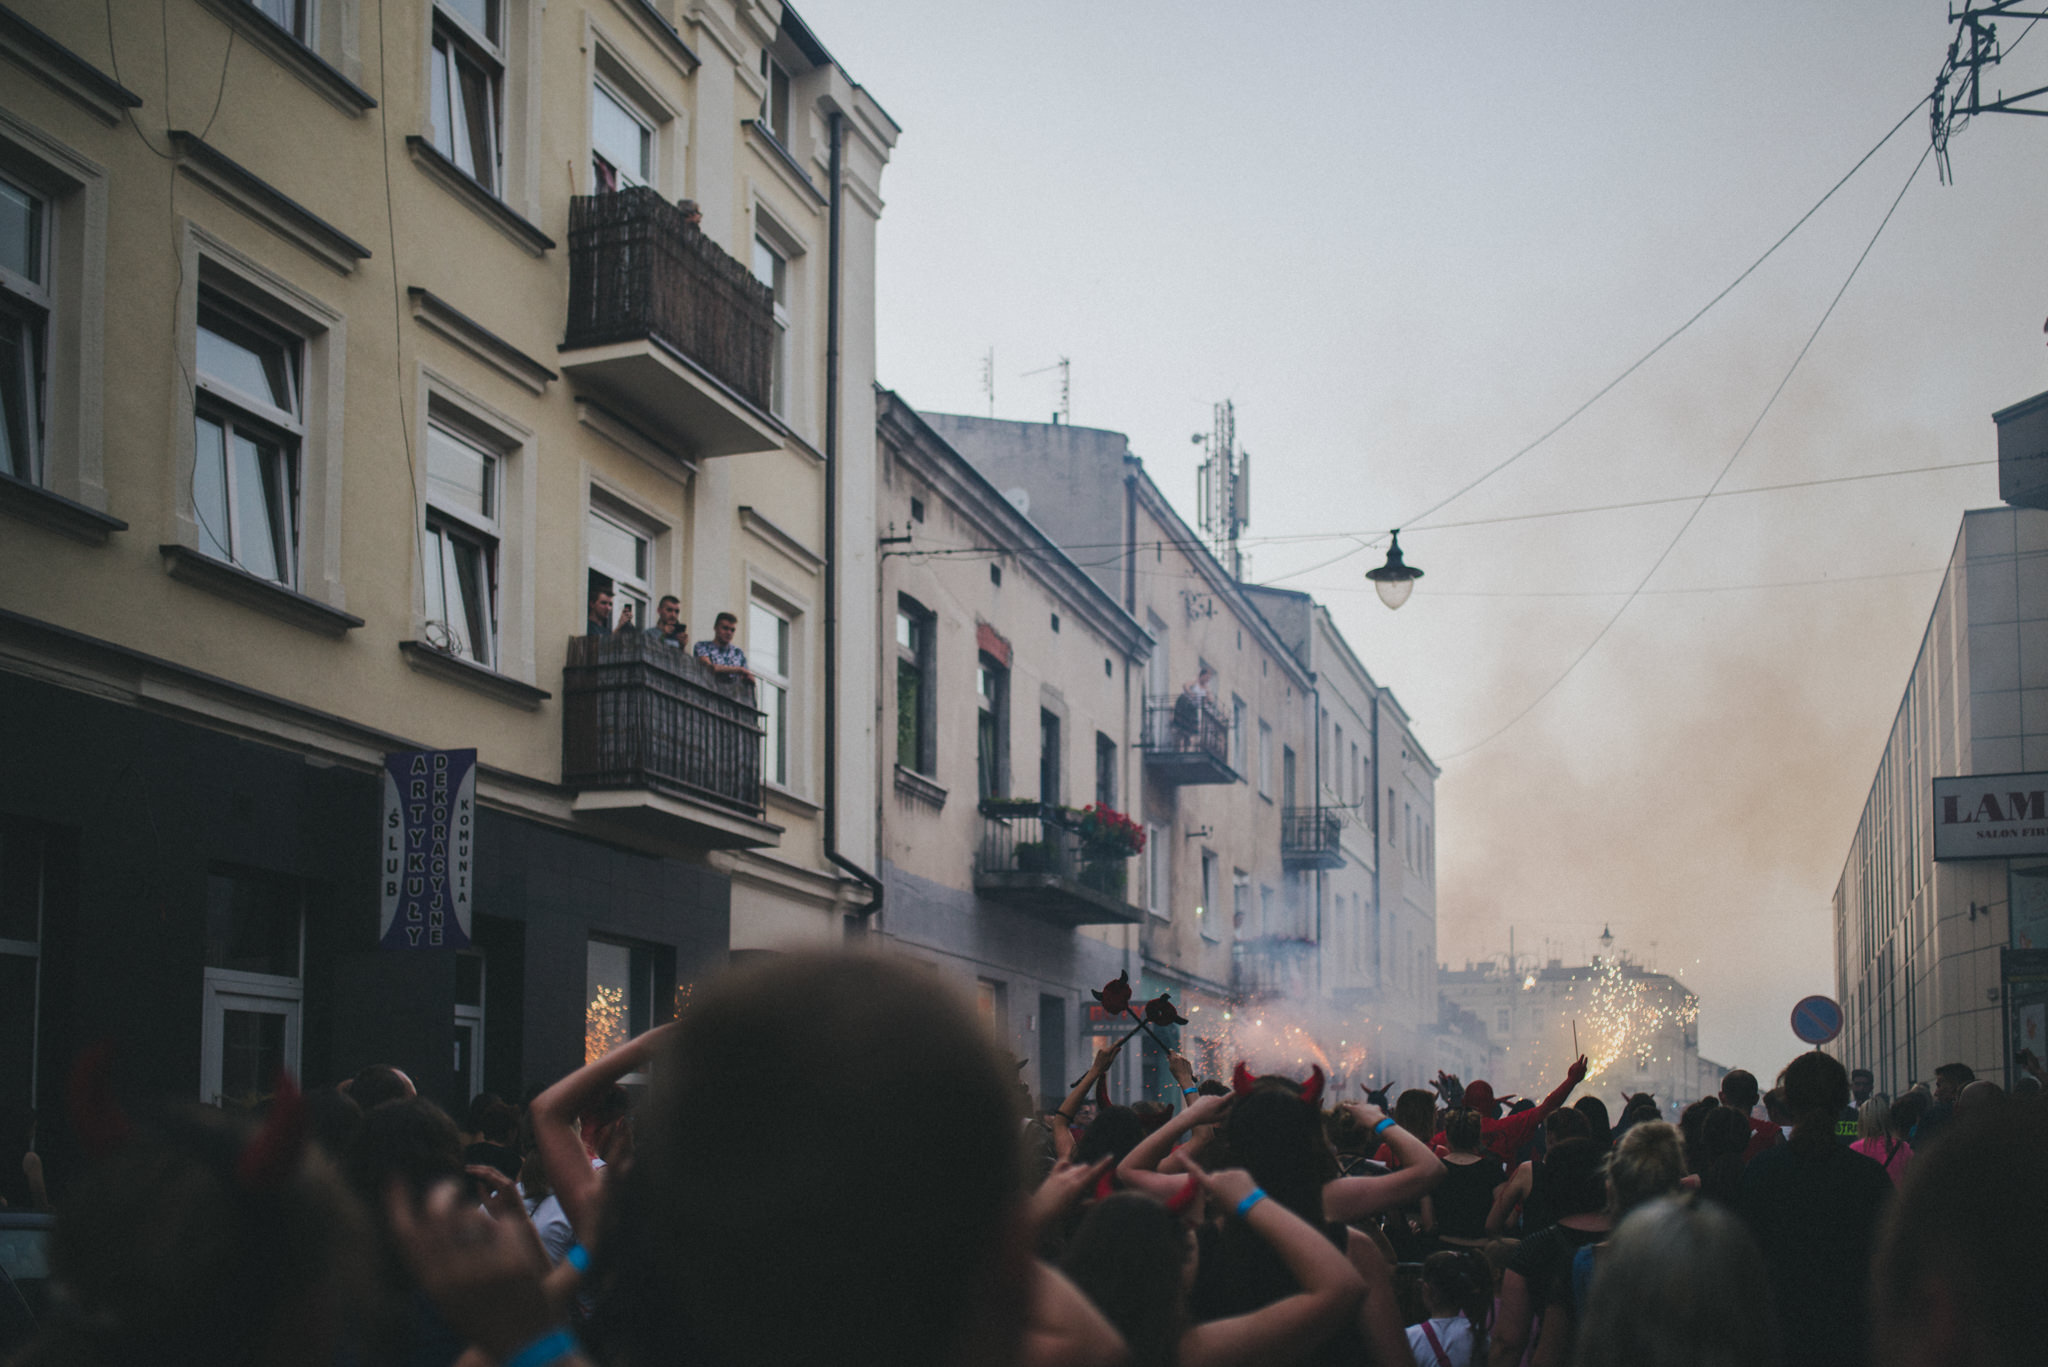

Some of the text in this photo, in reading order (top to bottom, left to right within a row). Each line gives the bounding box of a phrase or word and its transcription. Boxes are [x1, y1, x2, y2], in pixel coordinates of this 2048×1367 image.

[386, 808, 399, 897] ŚLUB
[407, 755, 427, 945] ARTYKUŁY
[430, 754, 447, 945] DEKORACYJNE
[458, 799, 469, 903] KOMUNIA
[1976, 827, 2048, 839] SALON FIR
